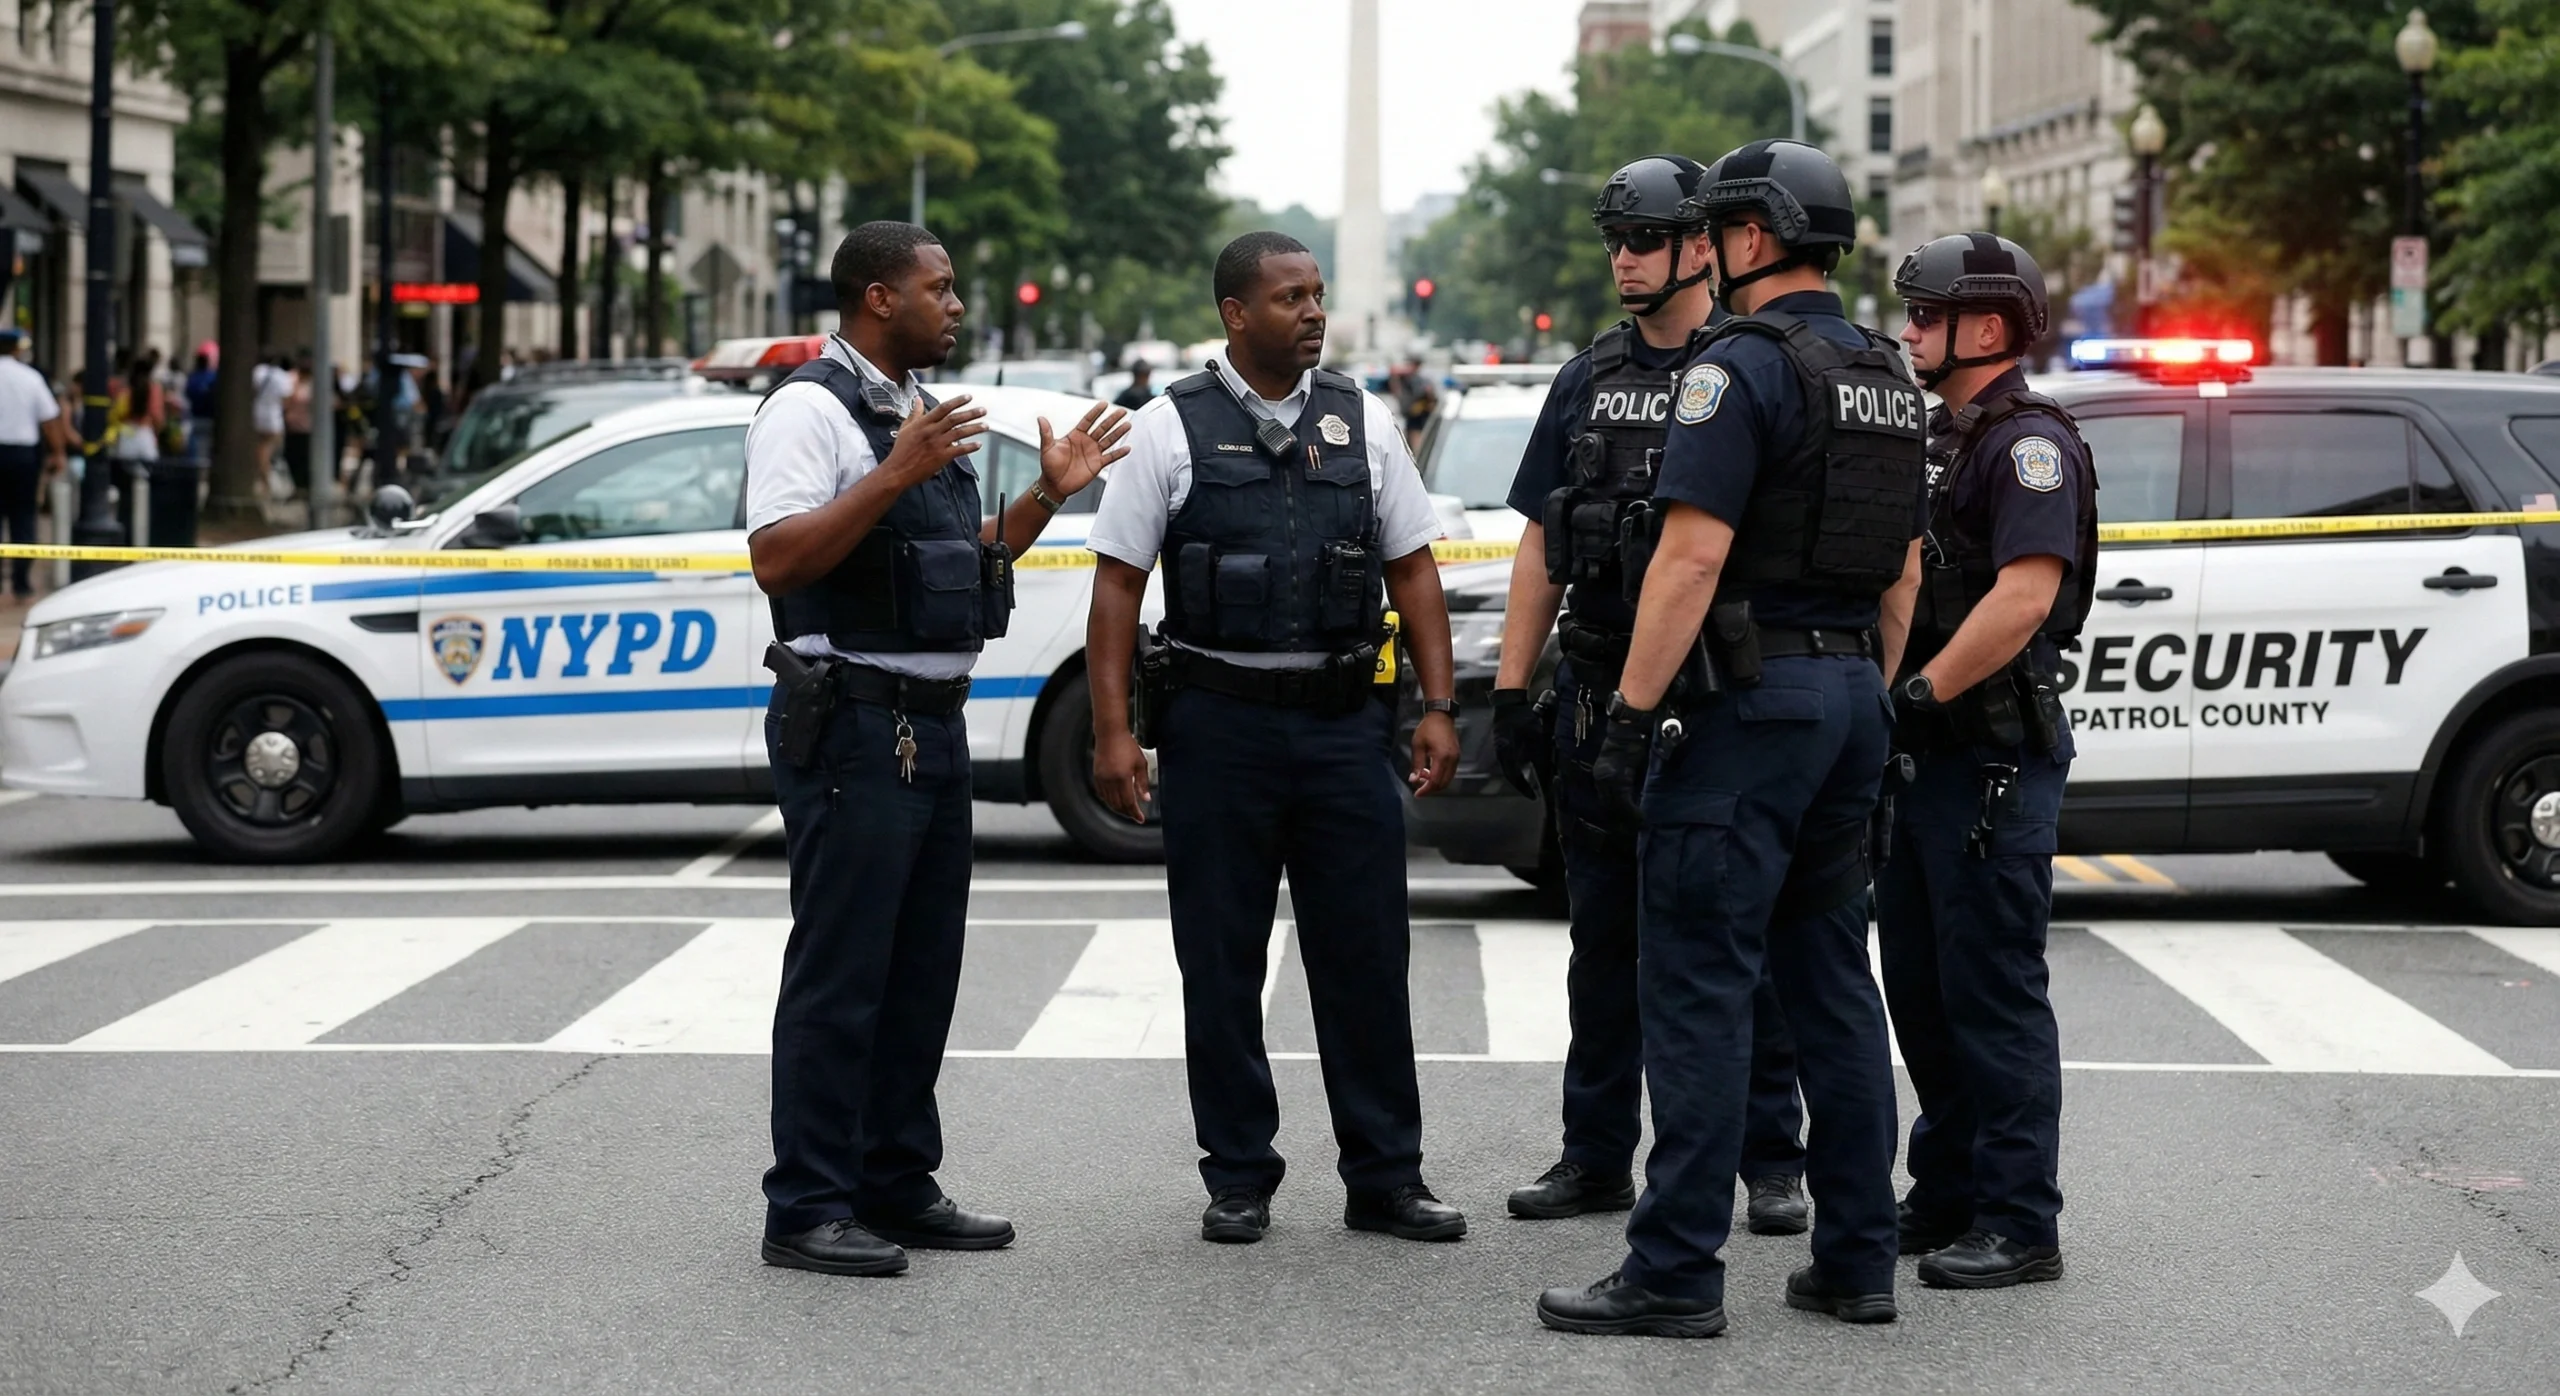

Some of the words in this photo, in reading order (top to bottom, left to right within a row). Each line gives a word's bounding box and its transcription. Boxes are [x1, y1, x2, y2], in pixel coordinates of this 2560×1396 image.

[1590, 391, 1670, 422] POLIC
[1836, 384, 1918, 430] POLICE
[198, 584, 304, 615] POLICE
[491, 609, 717, 680] NYPD
[2058, 628, 2429, 694] SECURITY
[2070, 705, 2189, 730] PATROL
[2201, 702, 2330, 727] COUNTY
